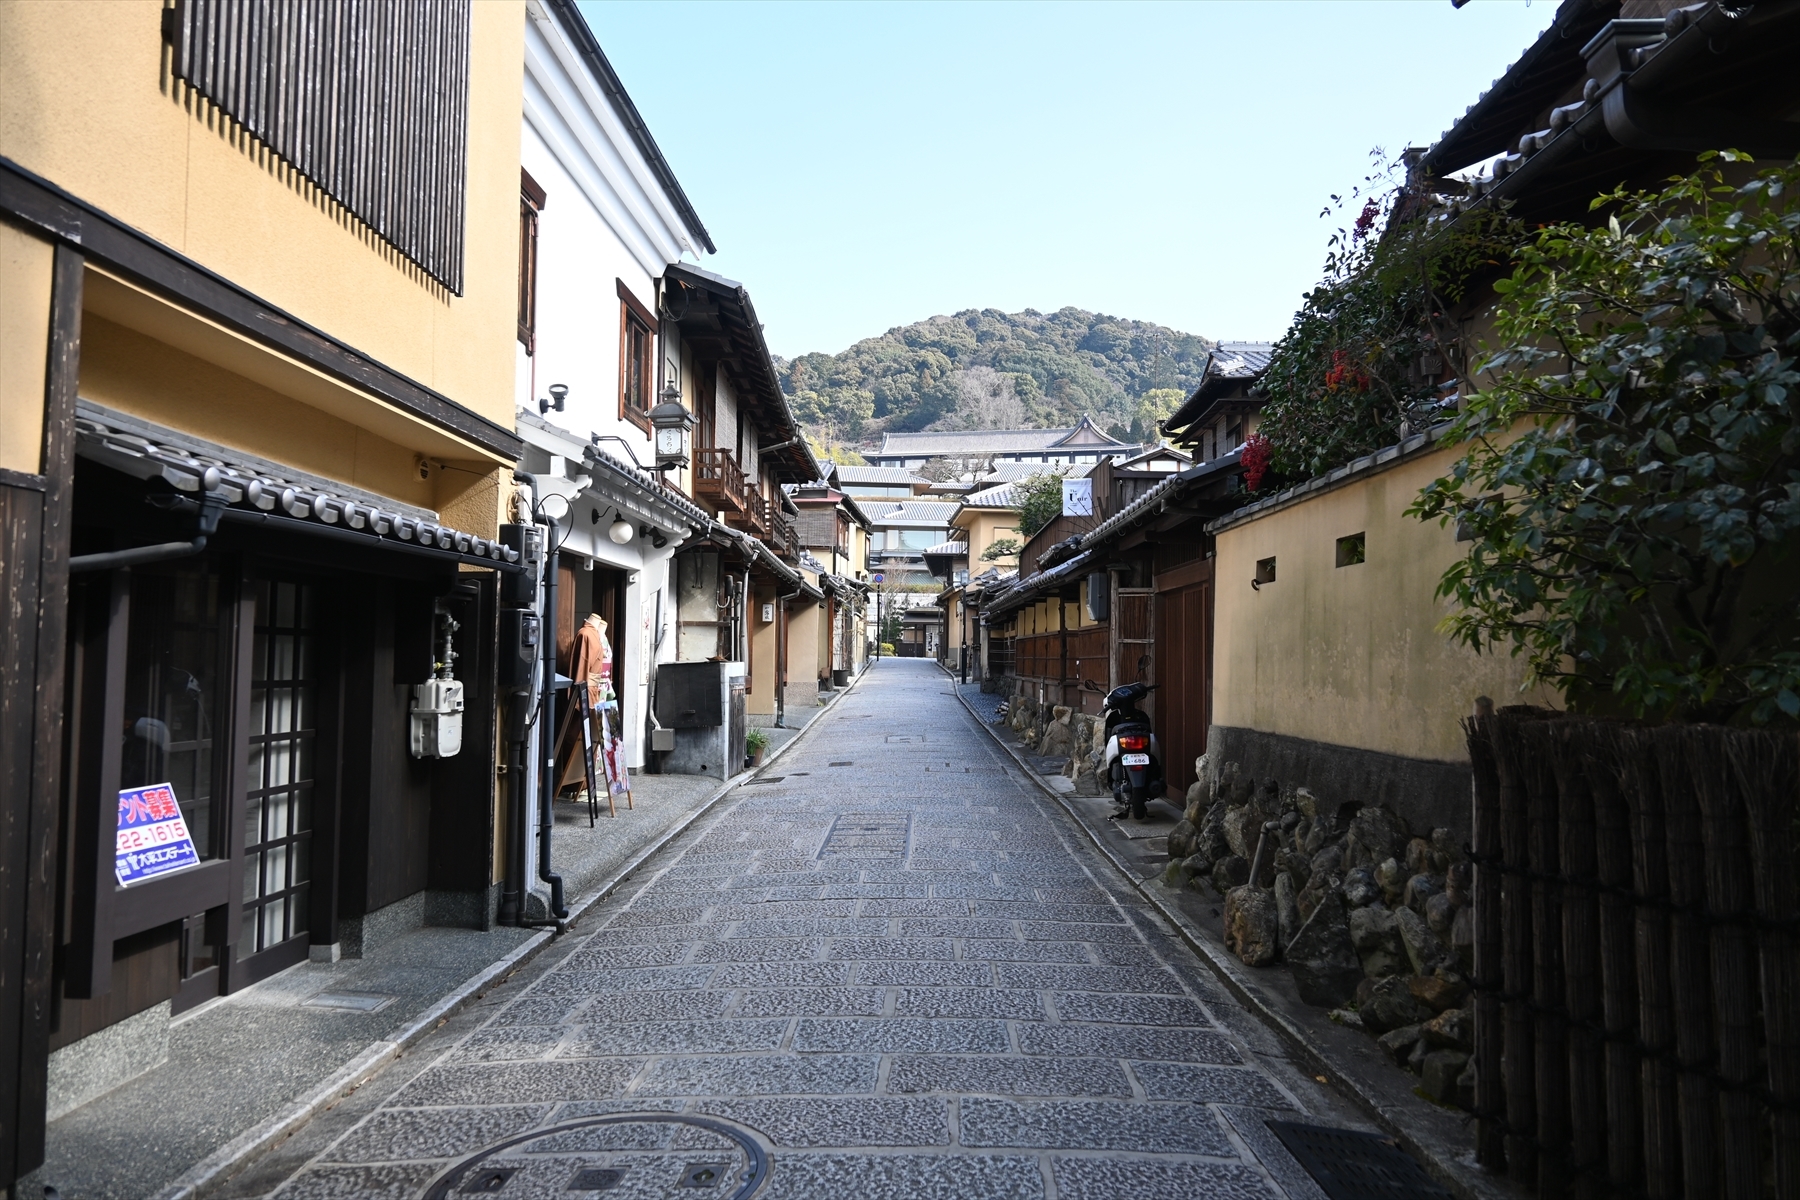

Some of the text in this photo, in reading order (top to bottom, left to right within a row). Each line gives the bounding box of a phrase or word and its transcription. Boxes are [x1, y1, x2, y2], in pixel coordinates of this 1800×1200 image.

[117, 788, 178, 826] ント募集
[117, 822, 186, 850] 22-1615
